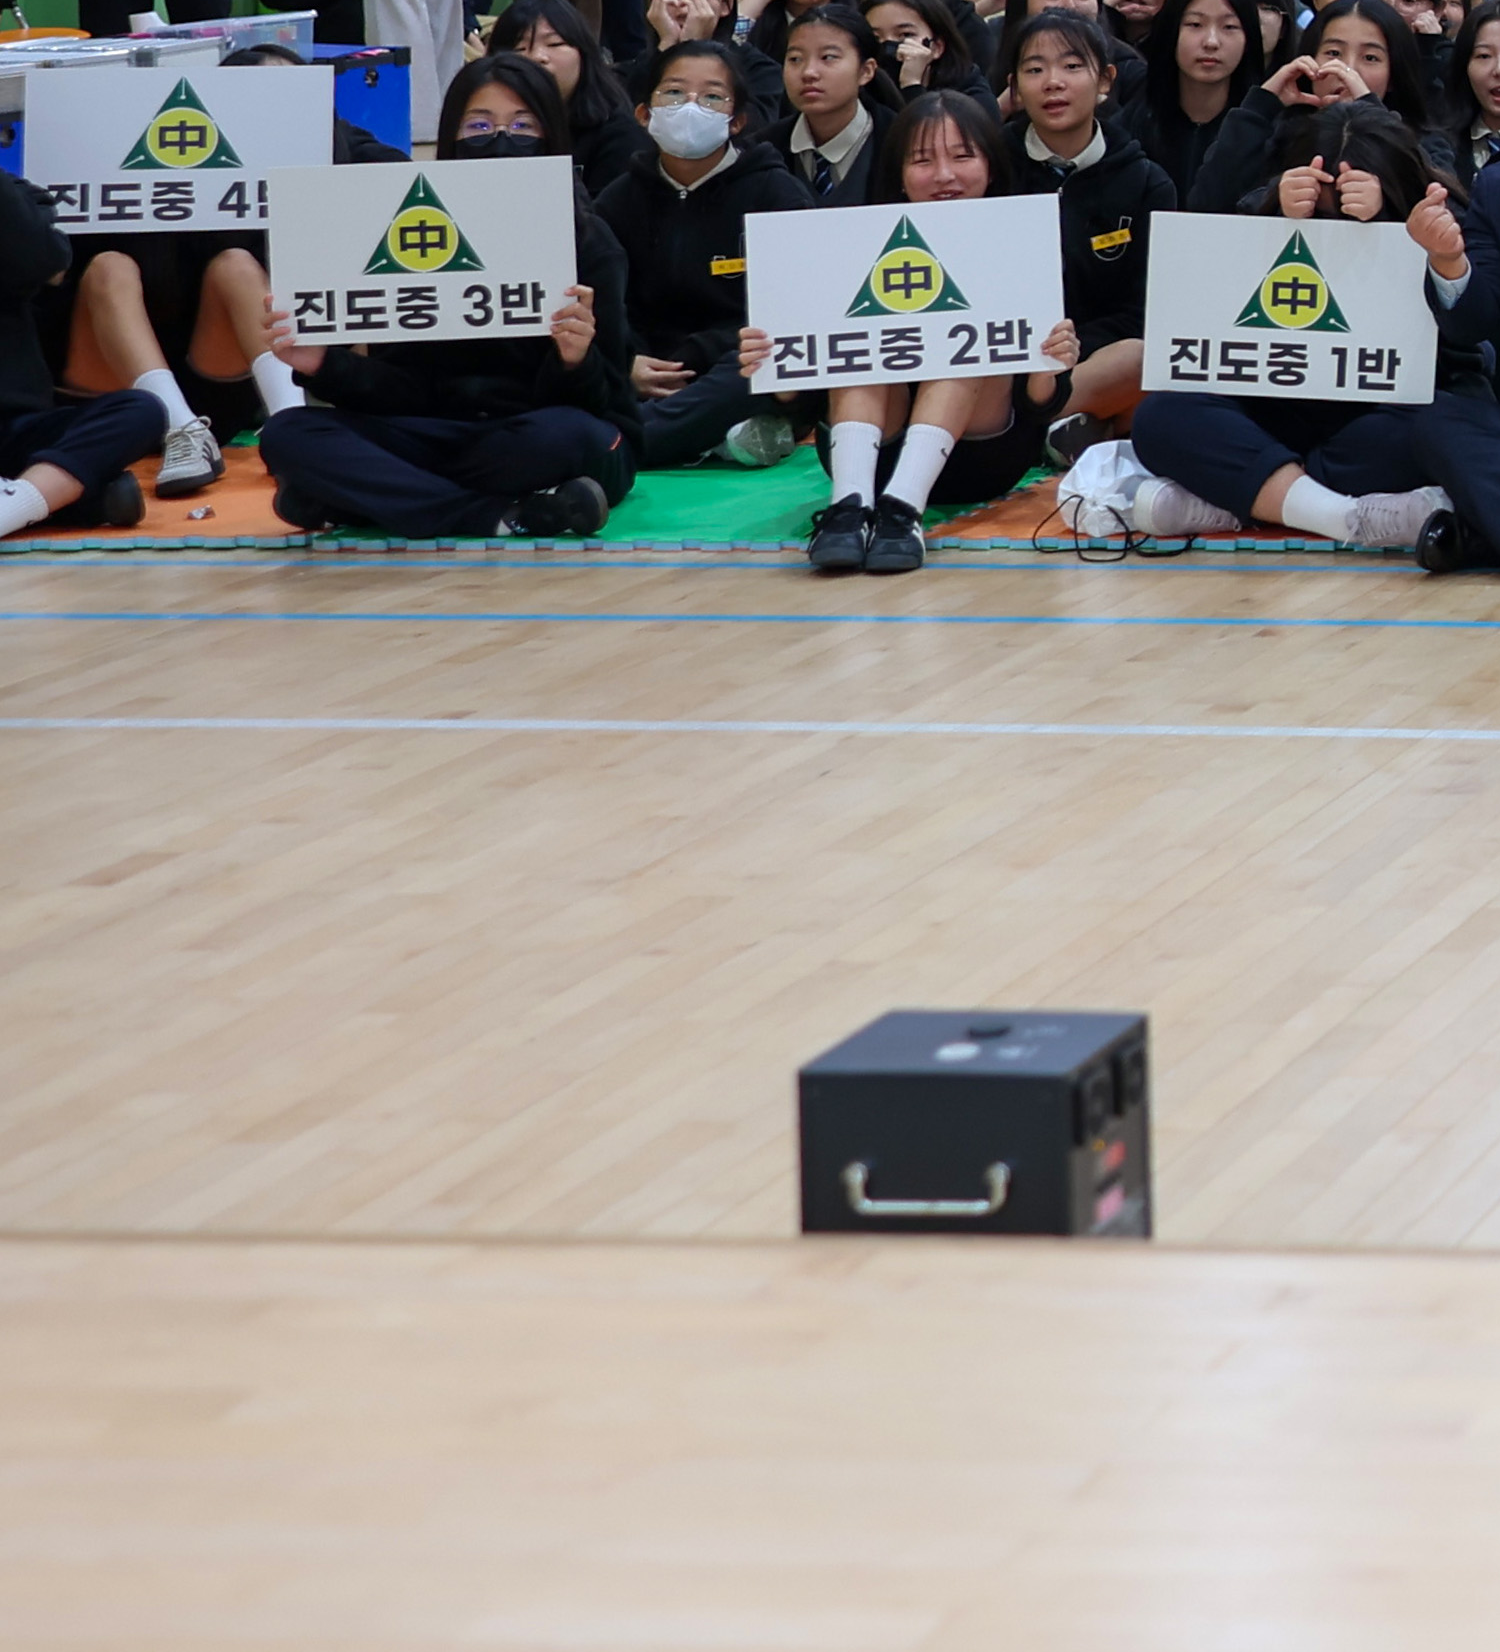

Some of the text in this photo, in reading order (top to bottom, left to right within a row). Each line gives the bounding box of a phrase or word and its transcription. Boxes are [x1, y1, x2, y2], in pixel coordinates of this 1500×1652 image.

[158, 119, 207, 156] 中
[48, 180, 196, 224] 진도중
[400, 219, 448, 258] 中
[882, 262, 933, 299] 中
[1271, 276, 1319, 315] 中
[294, 281, 546, 334] 진도중 3반
[773, 318, 1033, 380] 진도중 2반
[1168, 337, 1401, 392] 진도중 1반
